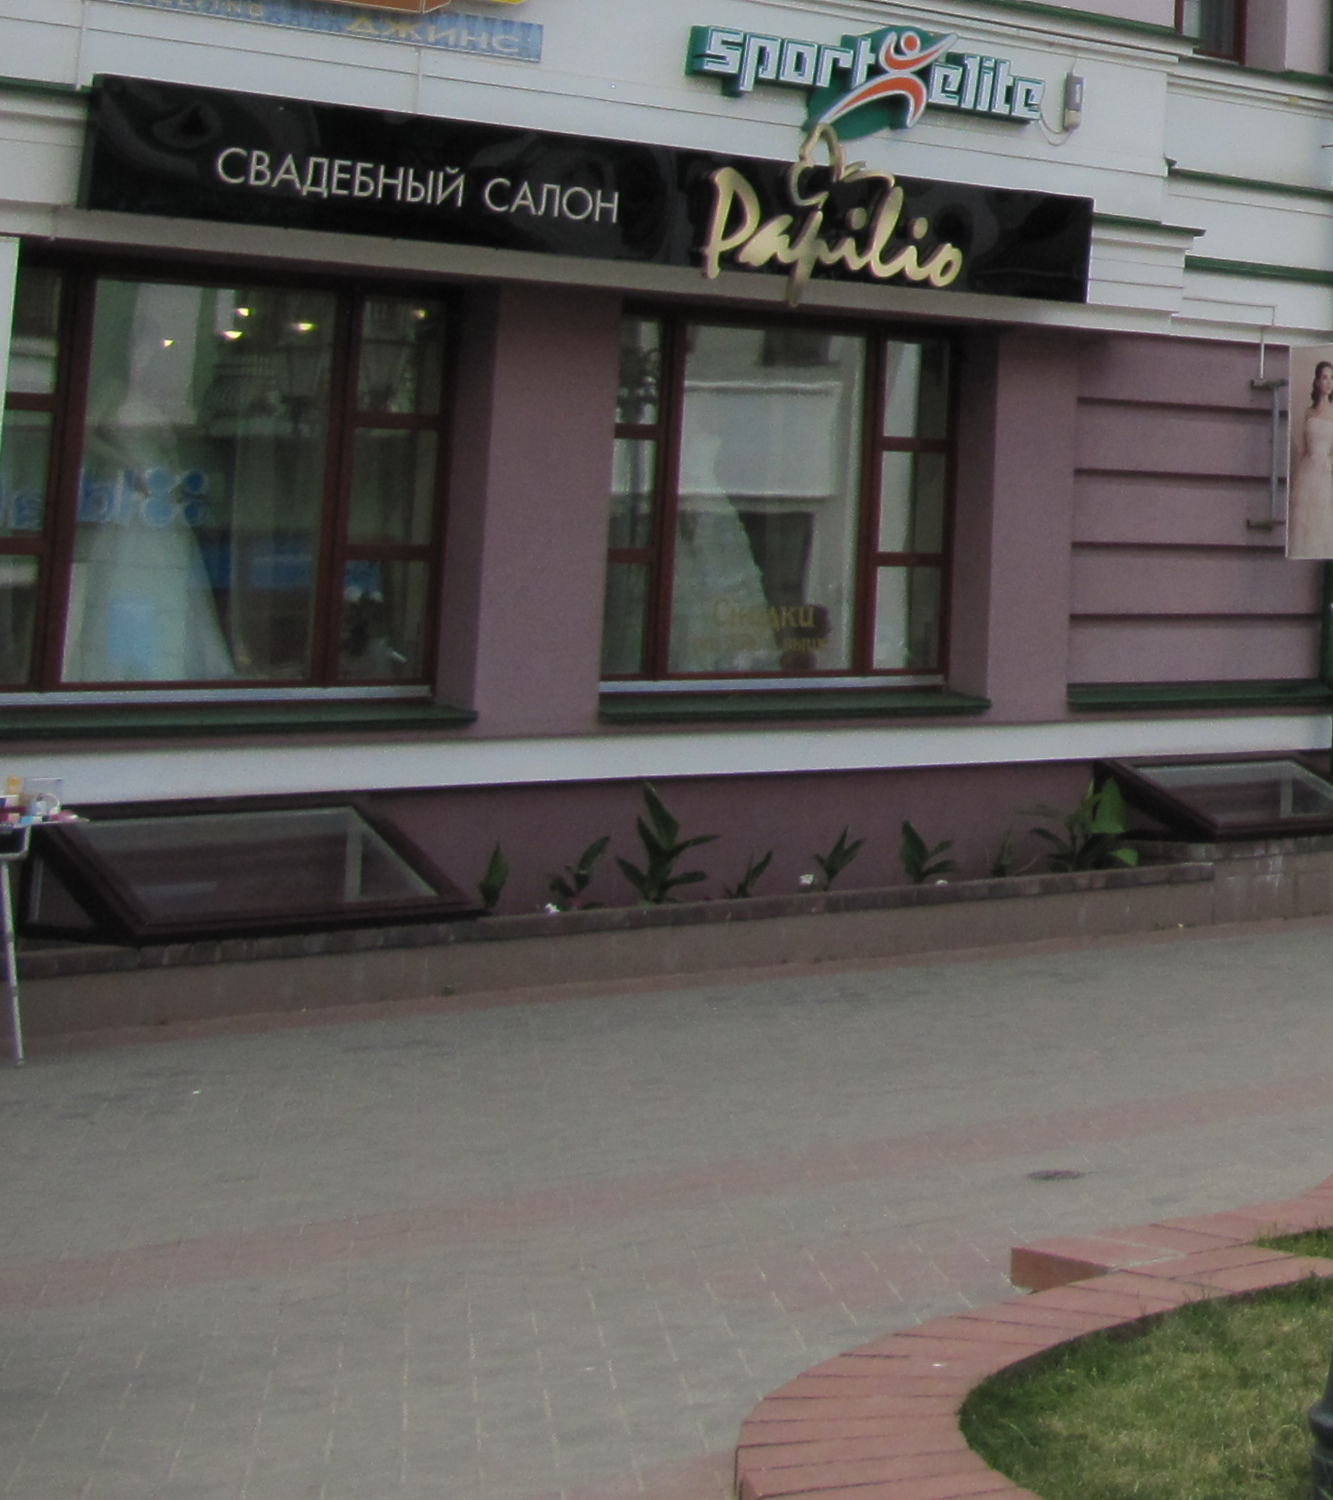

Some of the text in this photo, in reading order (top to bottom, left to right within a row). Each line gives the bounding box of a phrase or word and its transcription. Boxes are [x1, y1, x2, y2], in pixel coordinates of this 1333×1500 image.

[346, 14, 520, 54] ДЖИНС
[702, 25, 1046, 121] sport elite
[216, 146, 621, 225] СВАДЕБНЫЙ САЛОН
[700, 165, 964, 308] Papilio
